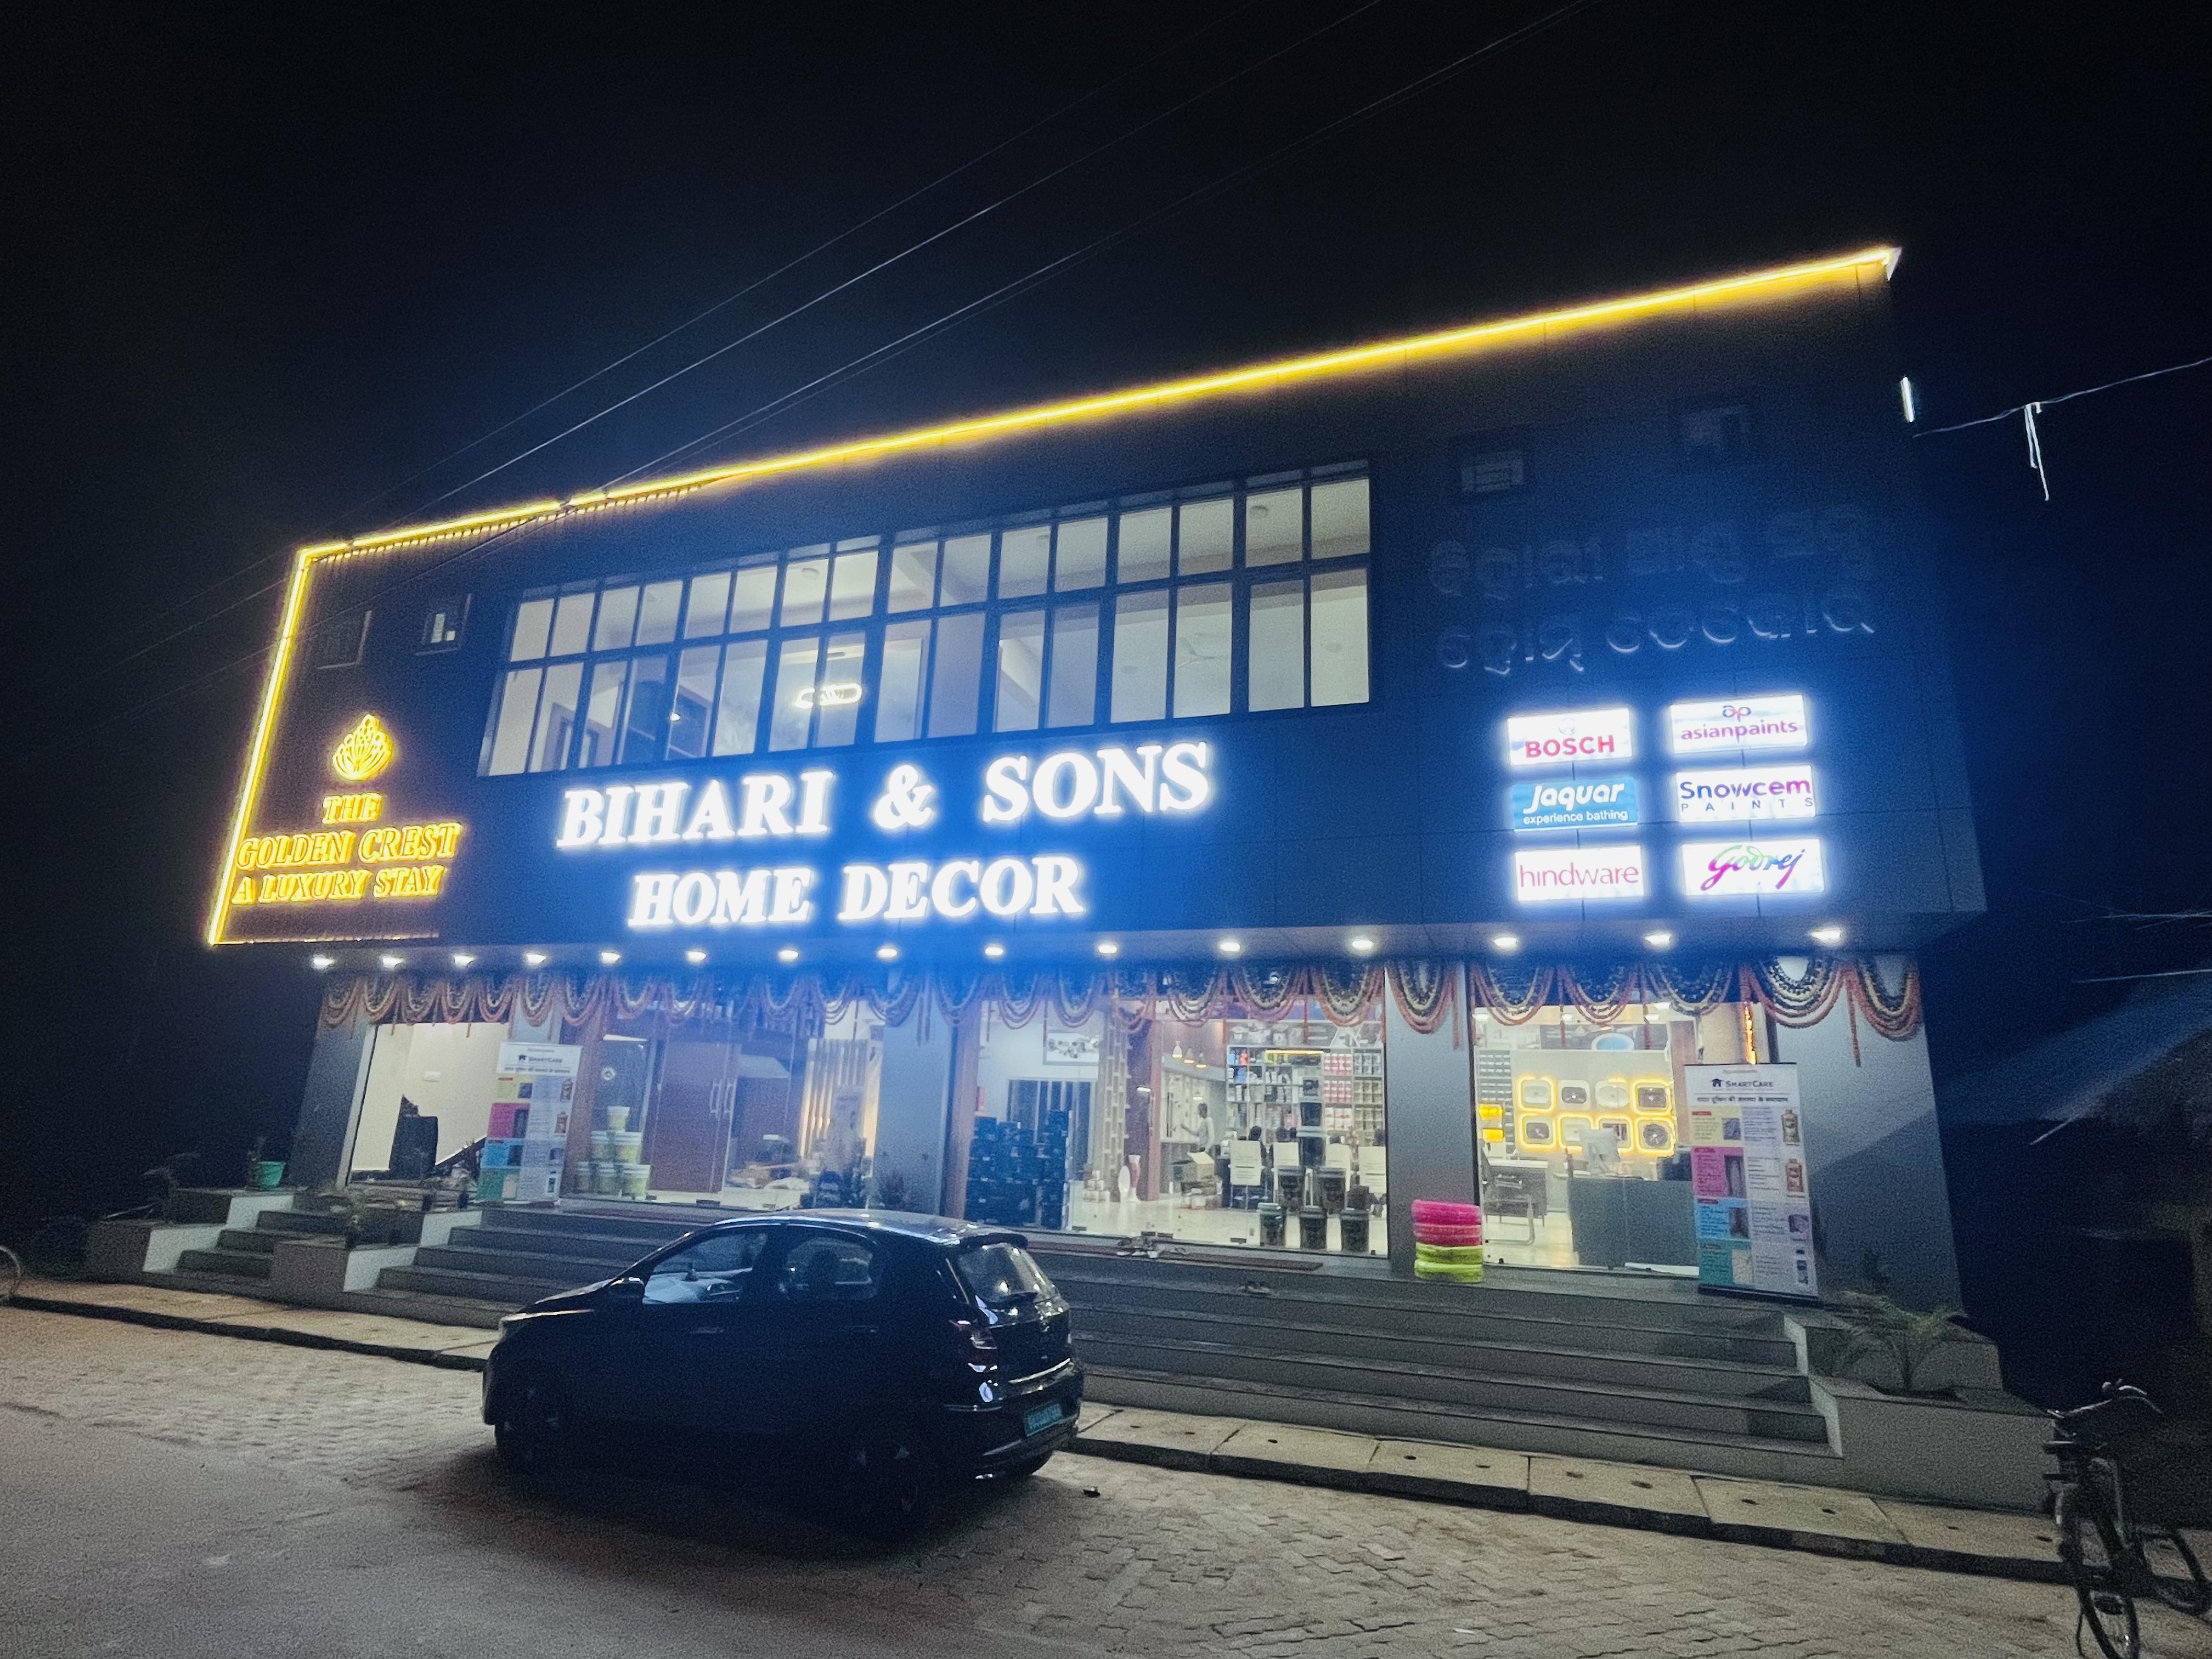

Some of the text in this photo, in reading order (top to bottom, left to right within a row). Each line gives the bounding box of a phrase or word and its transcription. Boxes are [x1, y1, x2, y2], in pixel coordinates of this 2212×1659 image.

[1525, 735, 1615, 758] BOSCH
[1681, 720, 1798, 743] asianpaints
[556, 742, 1209, 848] BIHARI & SONS
[1523, 783, 1624, 814] Jaquar
[1680, 780, 1811, 799] Snowcem
[1681, 798, 1813, 811] PAINTS
[323, 792, 382, 824] THE
[1523, 810, 1628, 826] experience bathing
[235, 822, 462, 871] GOLDEN CREST
[1520, 862, 1639, 887] hindware
[1700, 845, 1805, 891] Godrej
[232, 865, 445, 904] A LUXURY STAY
[628, 856, 1084, 927] HOME DECOR
